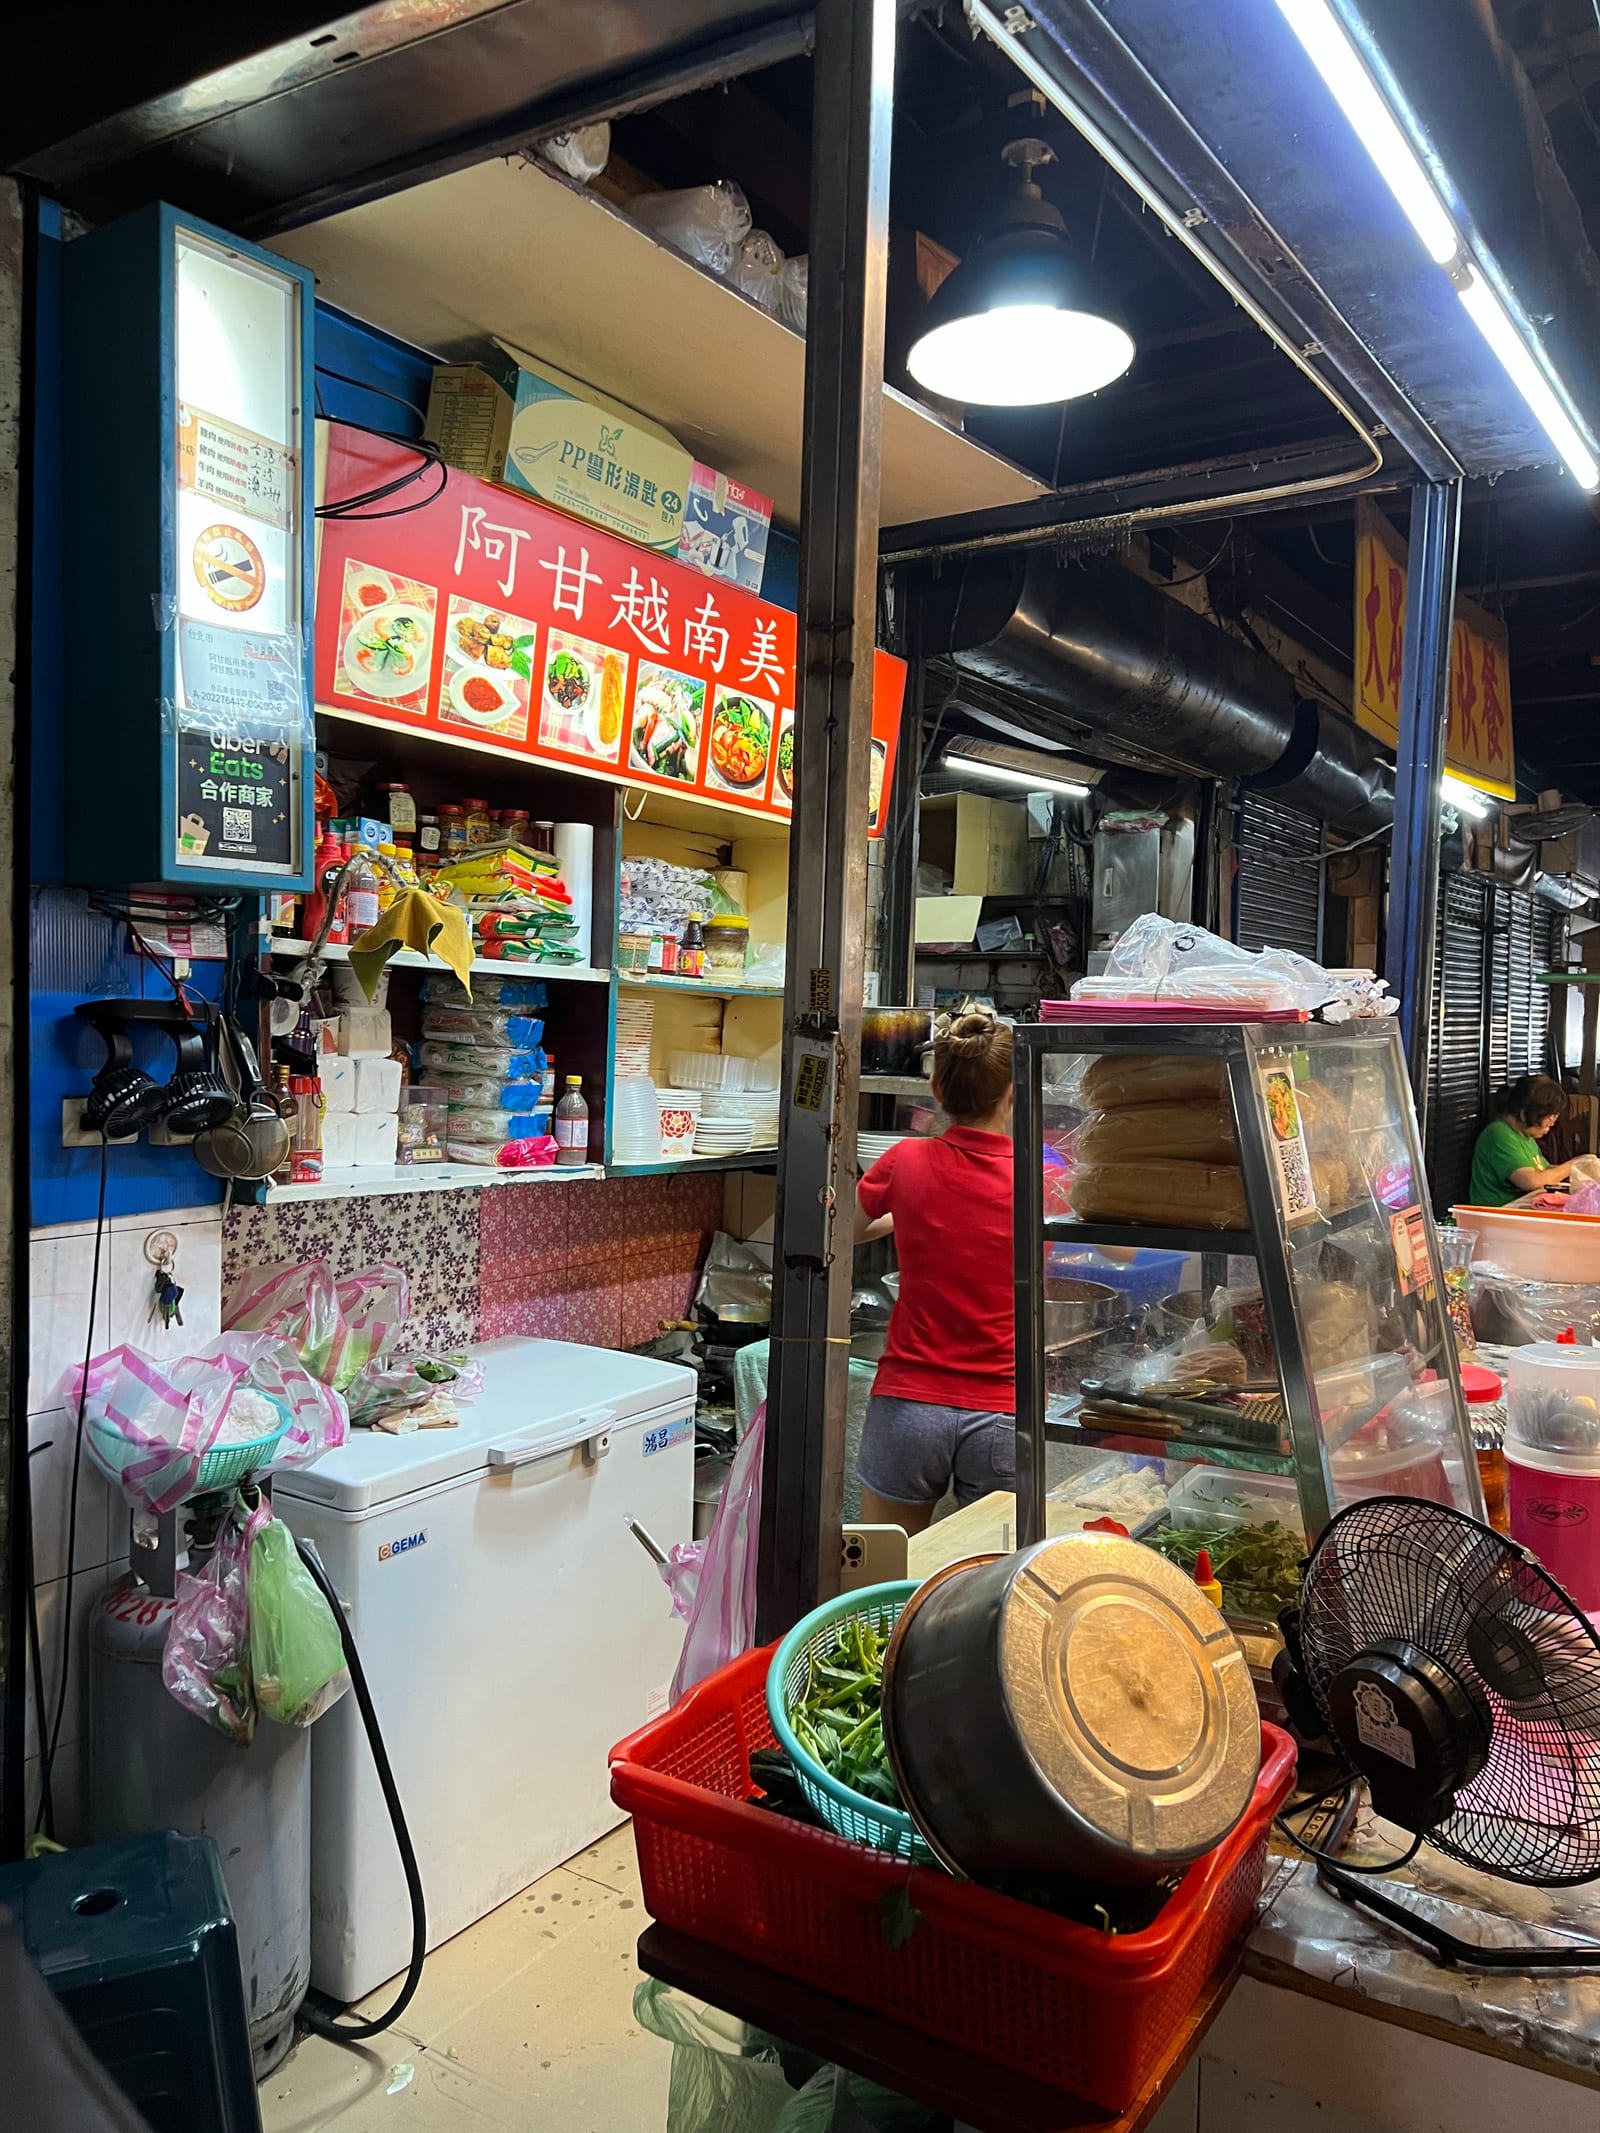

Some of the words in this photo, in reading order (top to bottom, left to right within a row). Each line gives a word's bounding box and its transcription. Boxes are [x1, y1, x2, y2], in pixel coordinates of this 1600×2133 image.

[664, 493, 679, 511] 24
[453, 504, 797, 696] 阿甘越南美
[209, 751, 264, 780] Eats
[200, 779, 273, 807] 合作商家
[391, 1531, 426, 1554] GEMA
